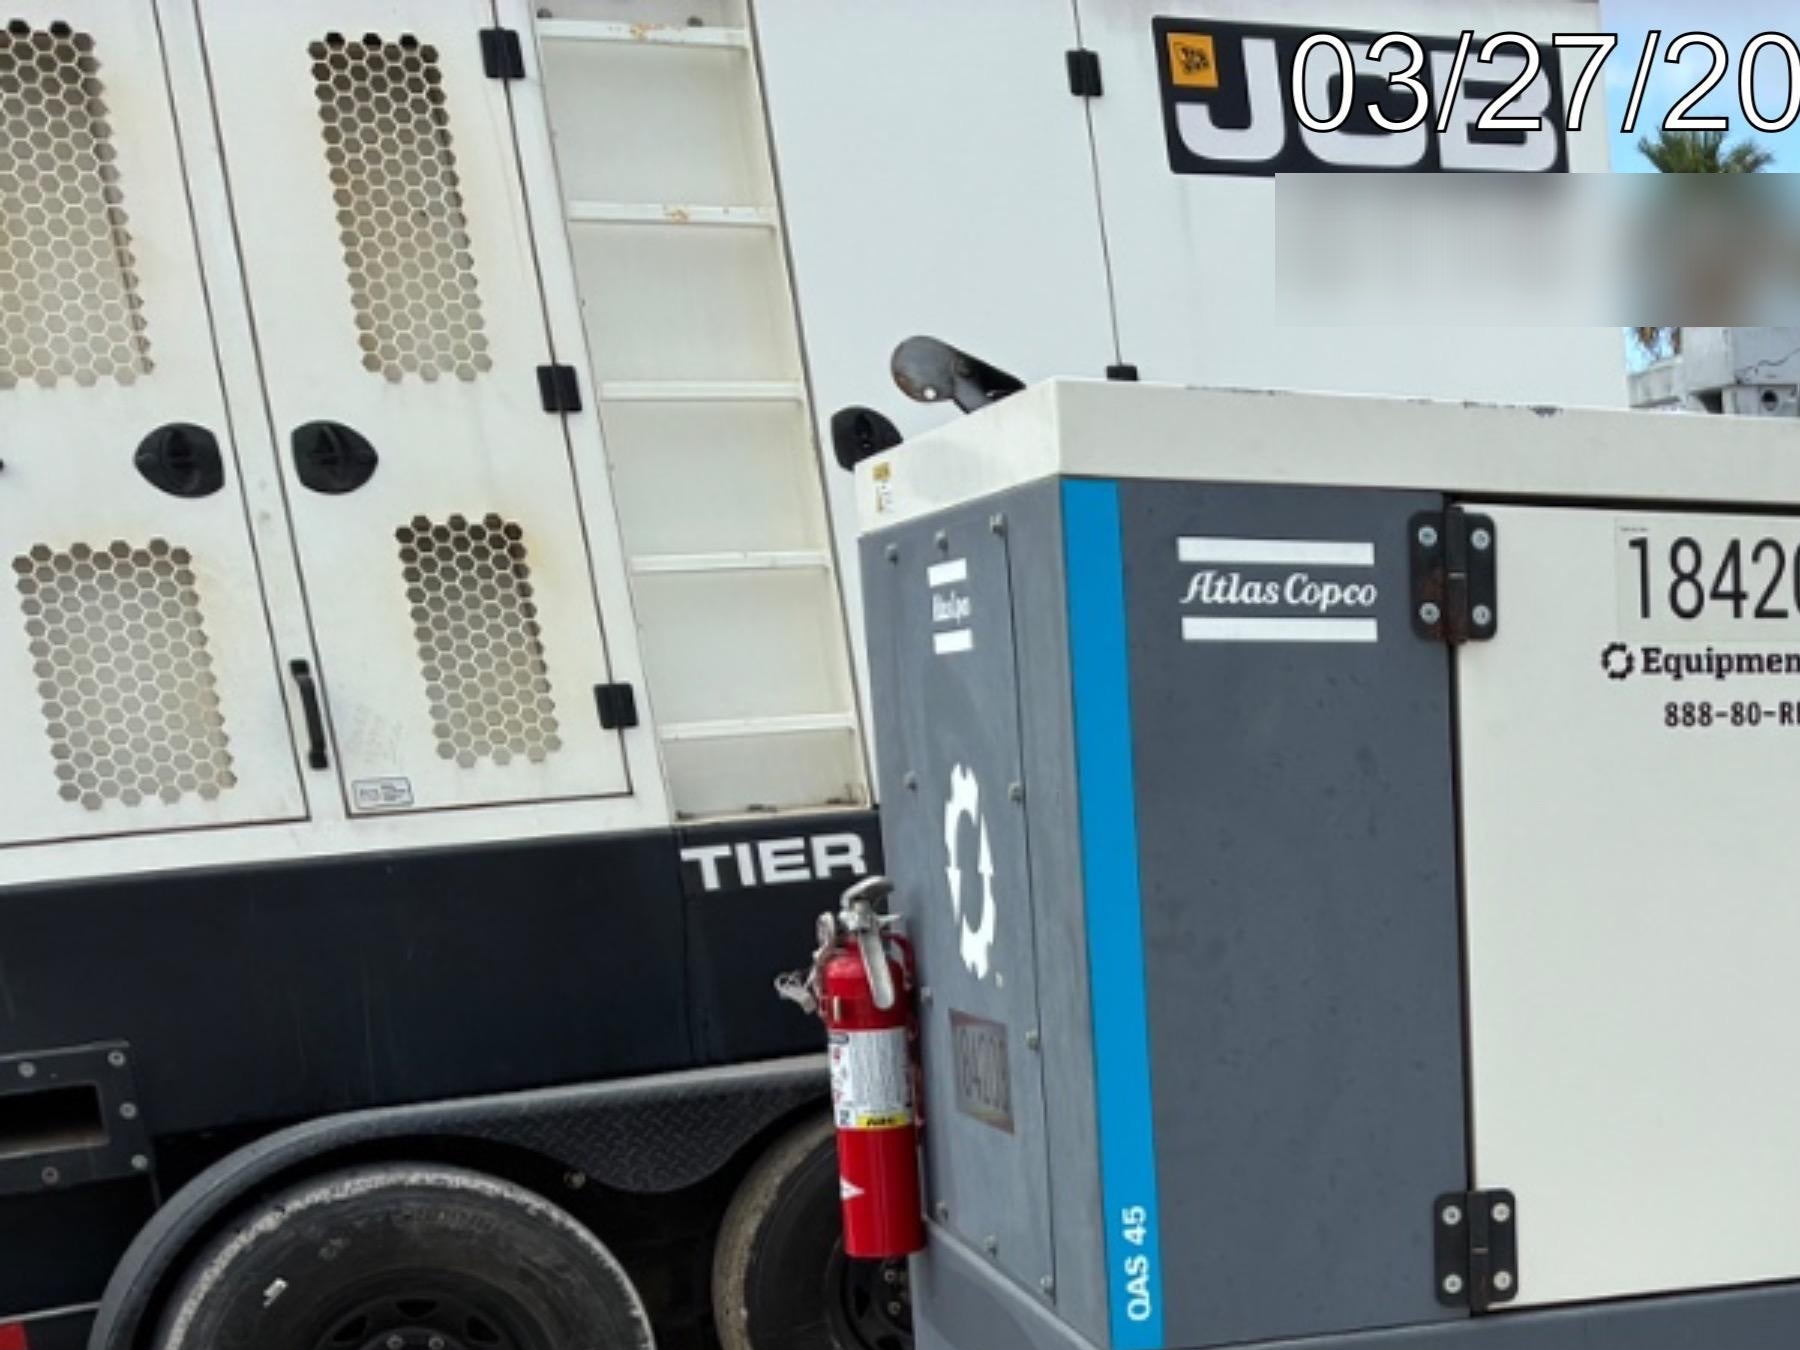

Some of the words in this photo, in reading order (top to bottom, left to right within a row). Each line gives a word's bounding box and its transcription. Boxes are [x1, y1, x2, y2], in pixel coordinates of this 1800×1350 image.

[1174, 37, 1558, 171] JCB
[1180, 570, 1279, 604] Atlas
[1283, 572, 1378, 613] Copco
[680, 833, 868, 892] TIER
[1121, 1204, 1148, 1247] 45
[1123, 1253, 1151, 1322] QAS
